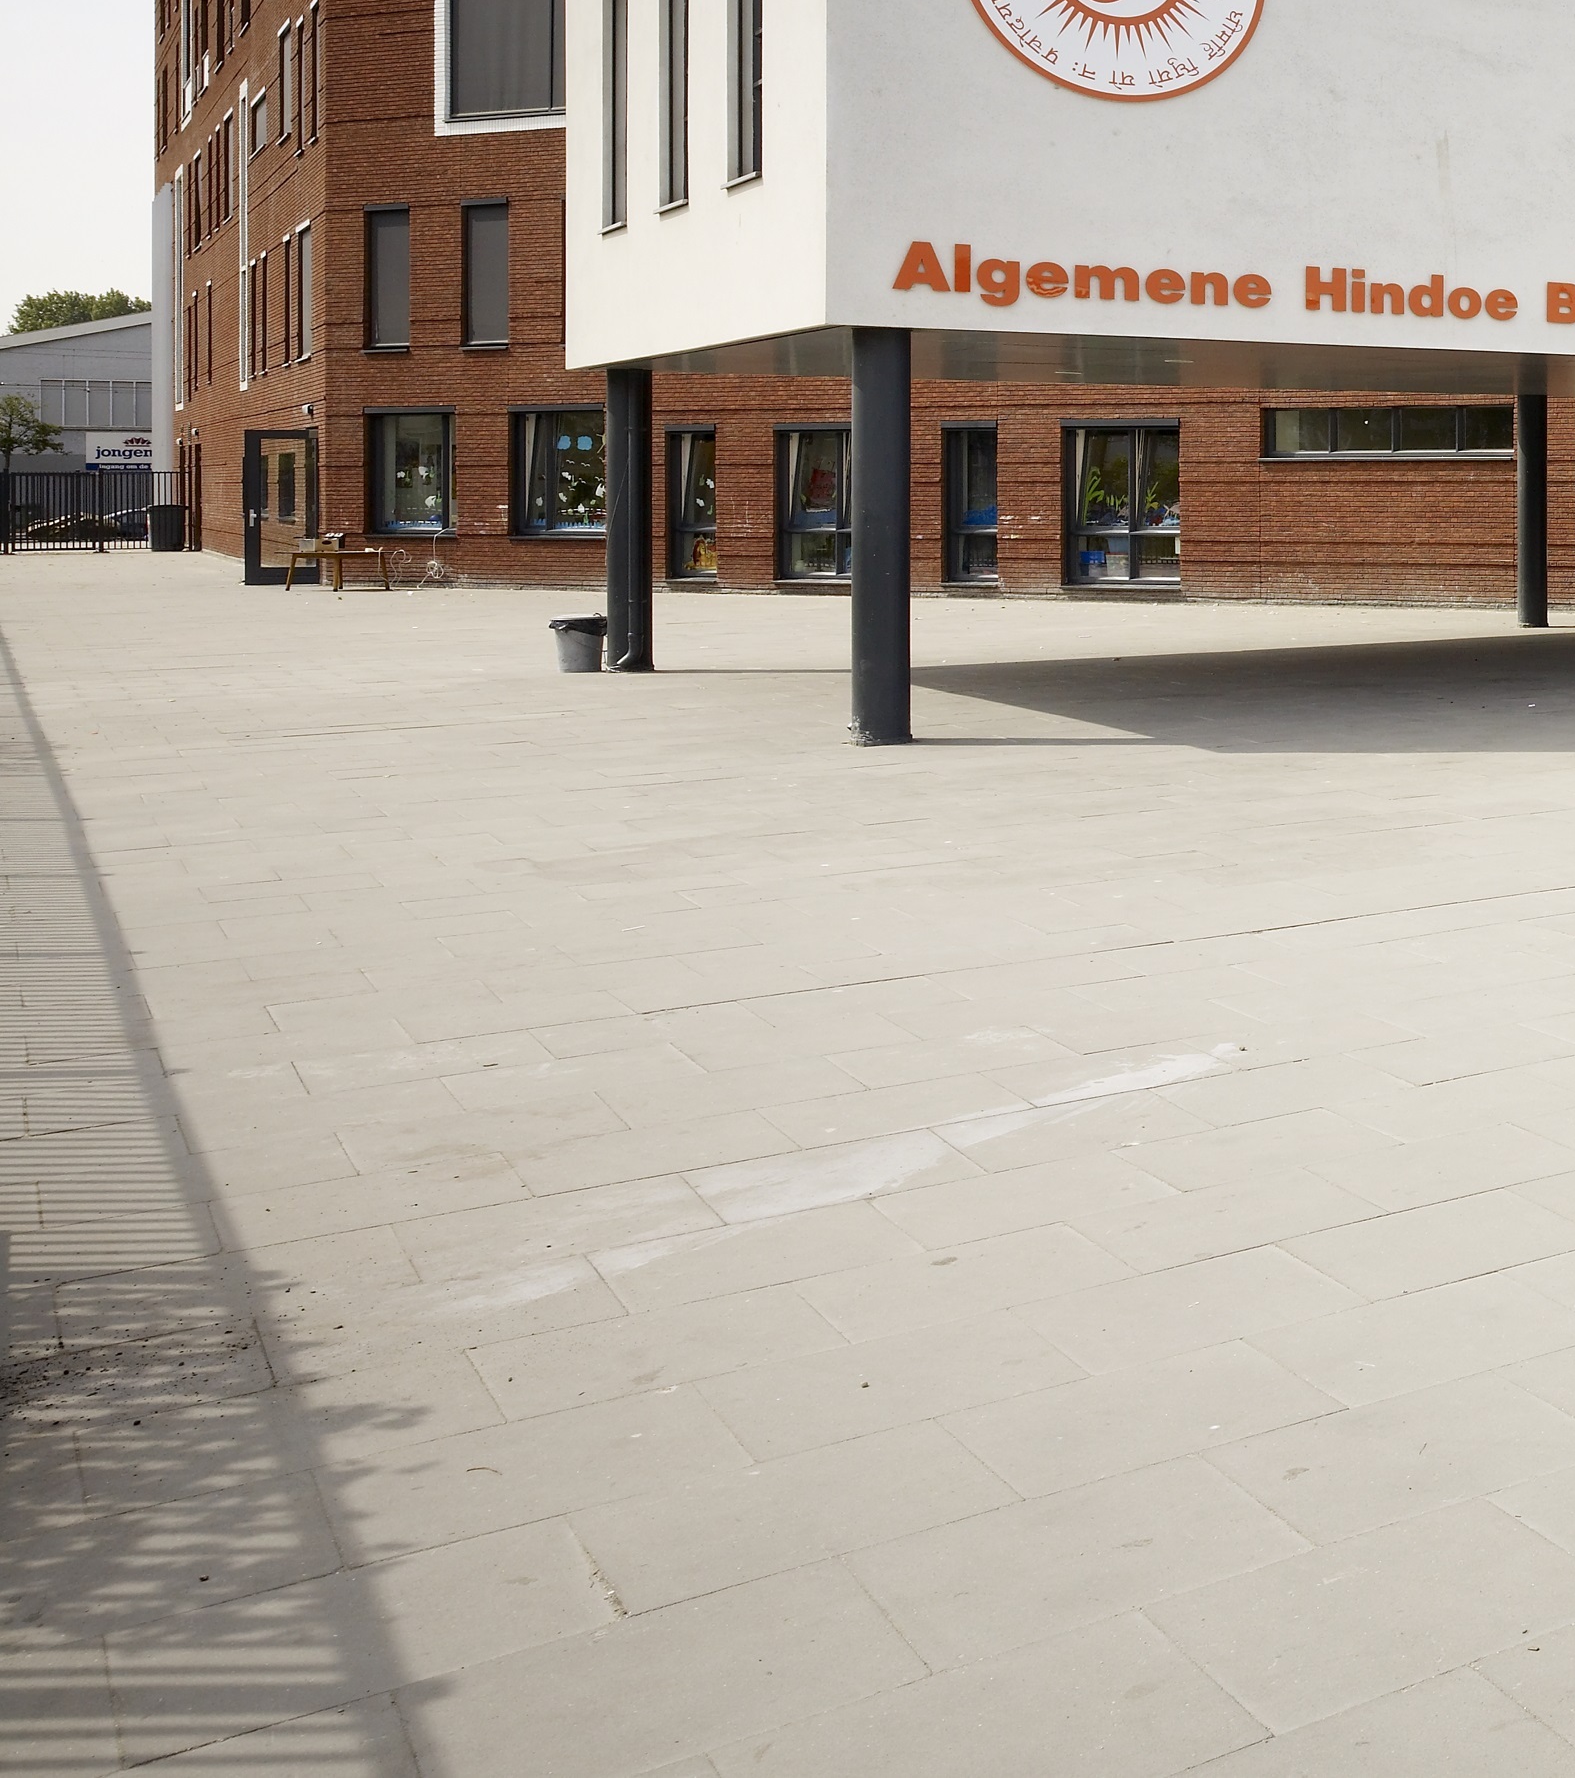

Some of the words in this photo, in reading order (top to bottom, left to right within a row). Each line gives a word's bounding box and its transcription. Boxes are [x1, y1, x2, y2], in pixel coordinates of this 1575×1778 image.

[1199, 10, 1244, 61] धीमहि
[892, 240, 1272, 308] Algemene
[1305, 265, 1519, 321] Hindoe
